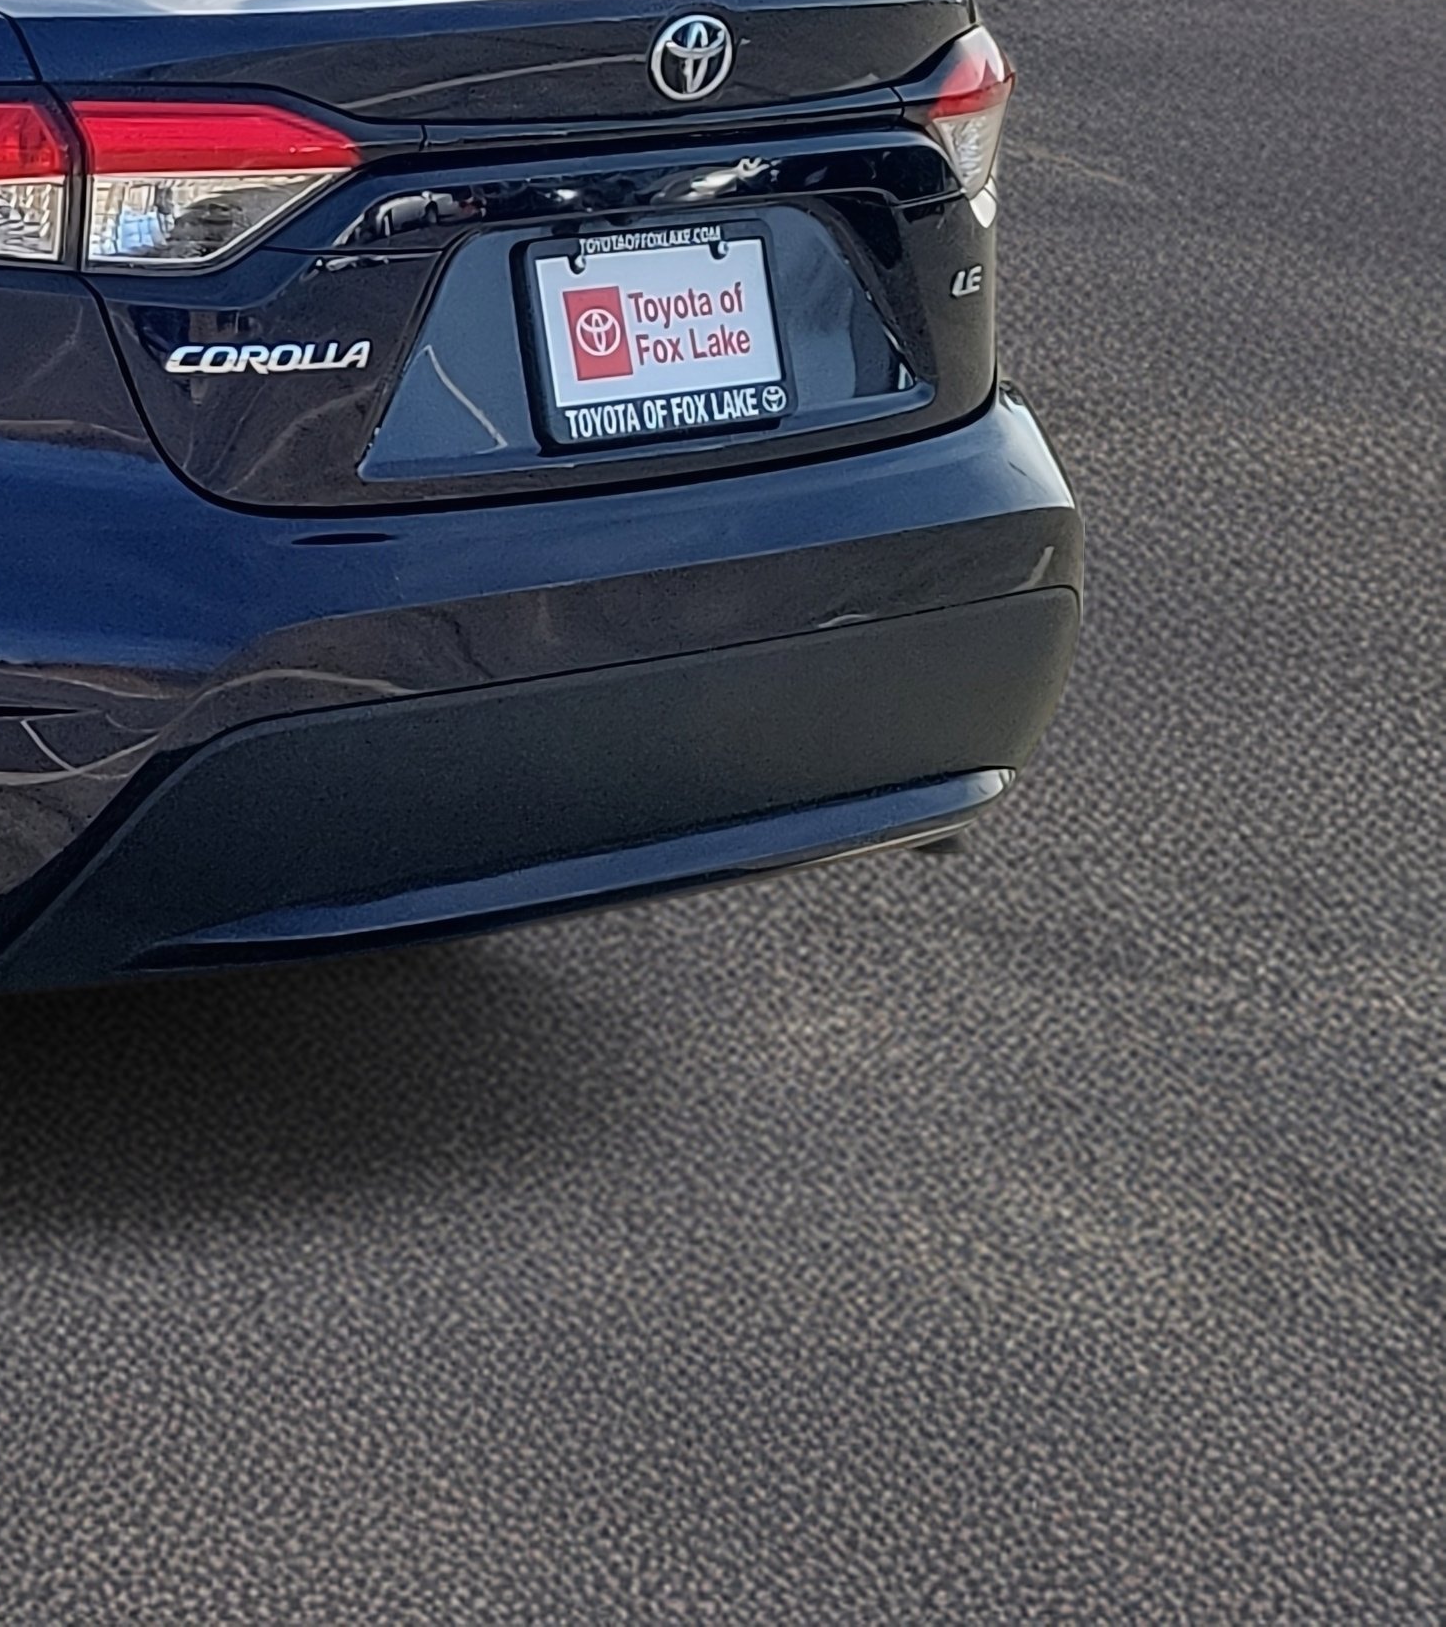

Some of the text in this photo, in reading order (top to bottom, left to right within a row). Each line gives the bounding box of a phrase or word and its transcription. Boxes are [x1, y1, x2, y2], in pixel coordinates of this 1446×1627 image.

[952, 266, 982, 297] LE
[628, 281, 743, 329] Toyota of
[165, 340, 371, 375] COROLLA
[635, 325, 751, 366] Fox Lake
[565, 388, 759, 439] TOYOTA OF FOX LAKE
